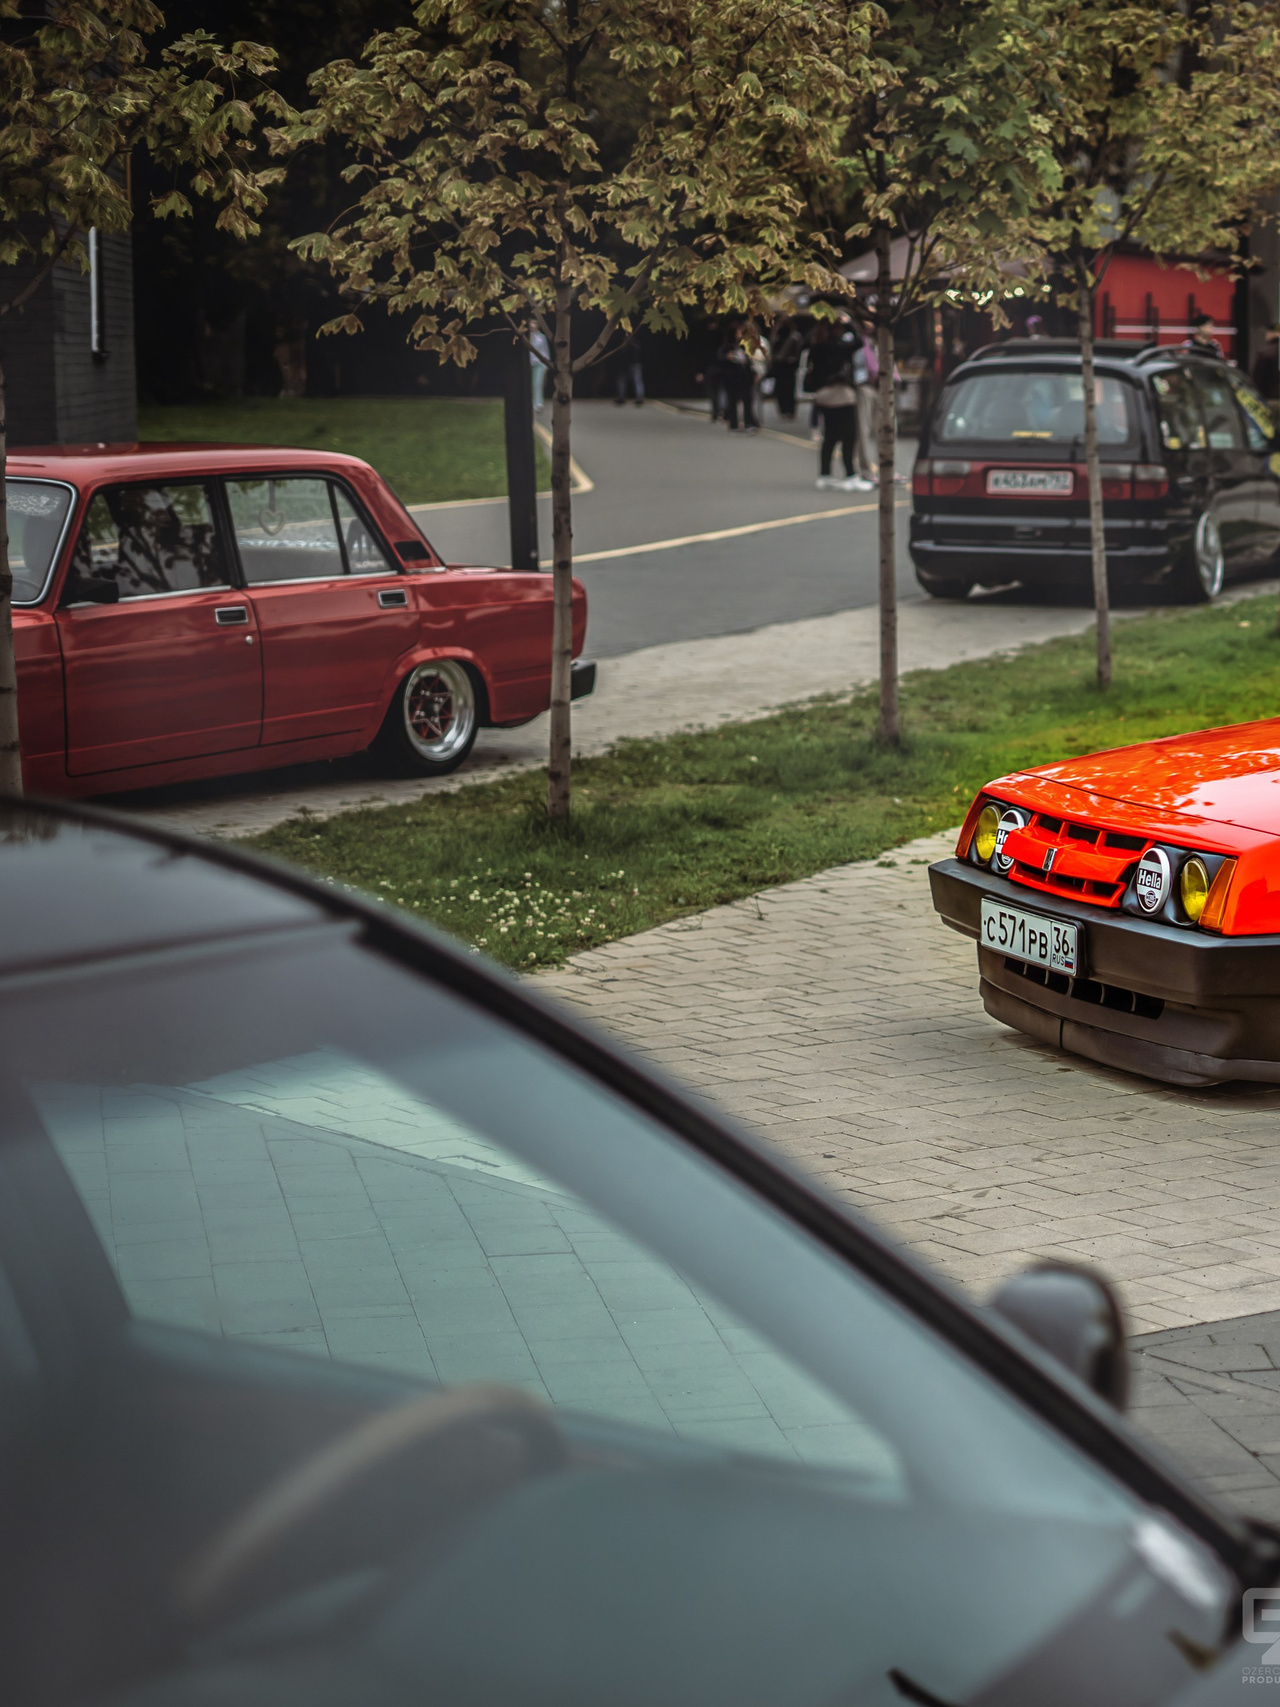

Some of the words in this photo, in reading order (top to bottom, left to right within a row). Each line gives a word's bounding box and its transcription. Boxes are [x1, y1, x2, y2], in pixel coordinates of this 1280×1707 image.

[1138, 869, 1162, 889] Hella
[1053, 926, 1070, 956] 36
[1052, 953, 1065, 966] RUS
